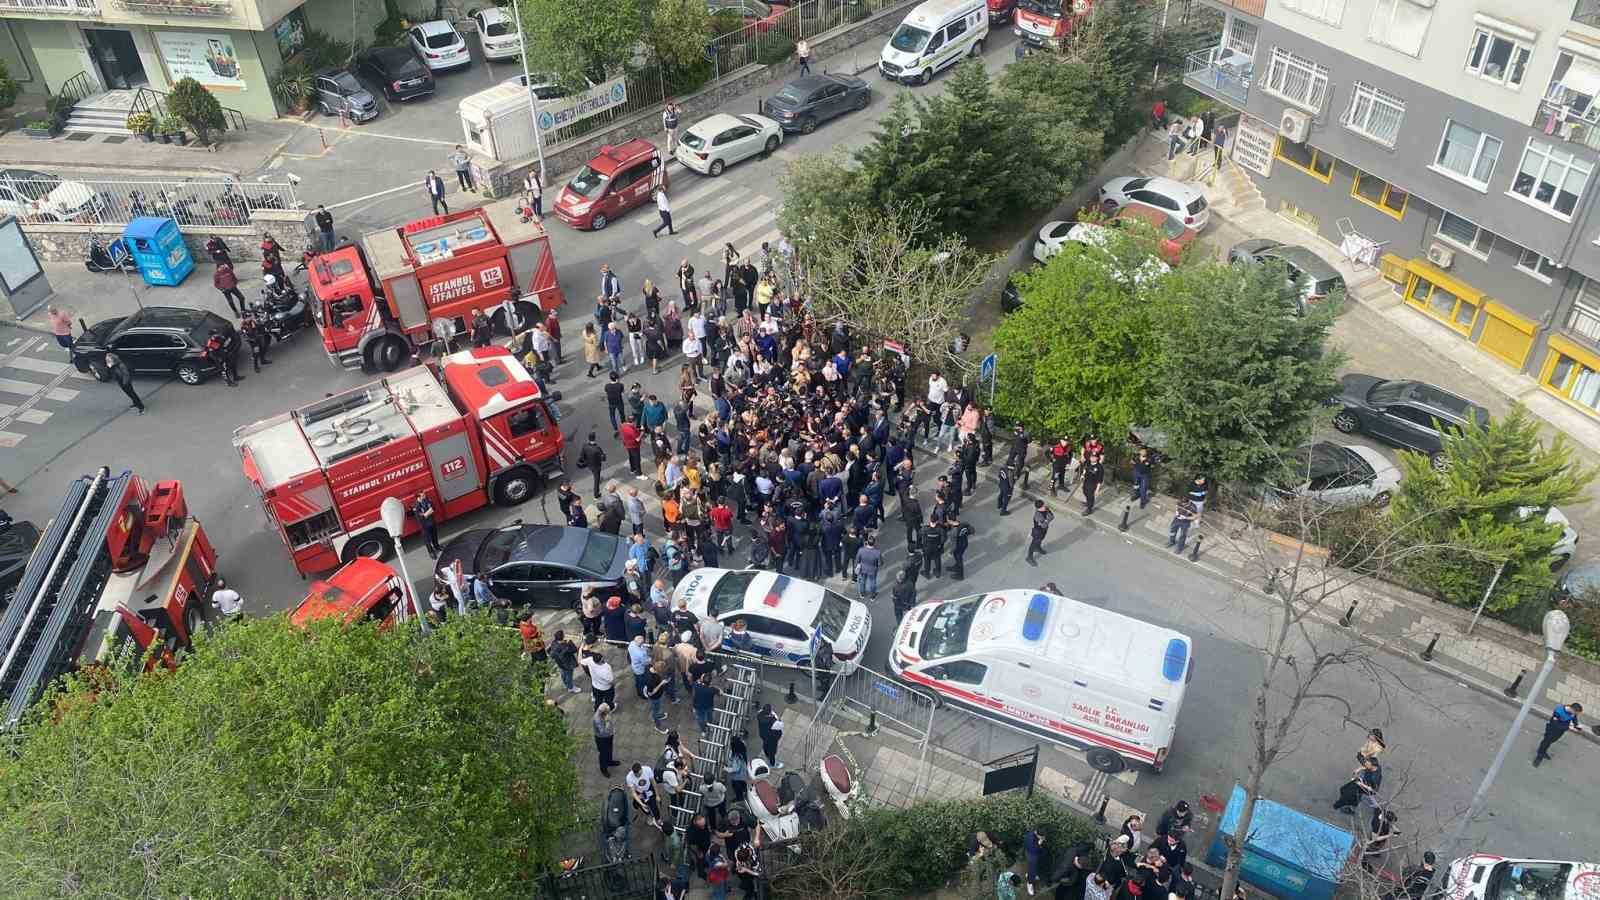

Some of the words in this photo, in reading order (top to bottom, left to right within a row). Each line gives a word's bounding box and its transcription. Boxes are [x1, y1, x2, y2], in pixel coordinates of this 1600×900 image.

[430, 274, 474, 295] İSTANBUL
[483, 269, 499, 281] 112
[432, 283, 476, 304] İTFAİYESİ
[443, 459, 464, 473] 112
[341, 479, 381, 498] STANBUL
